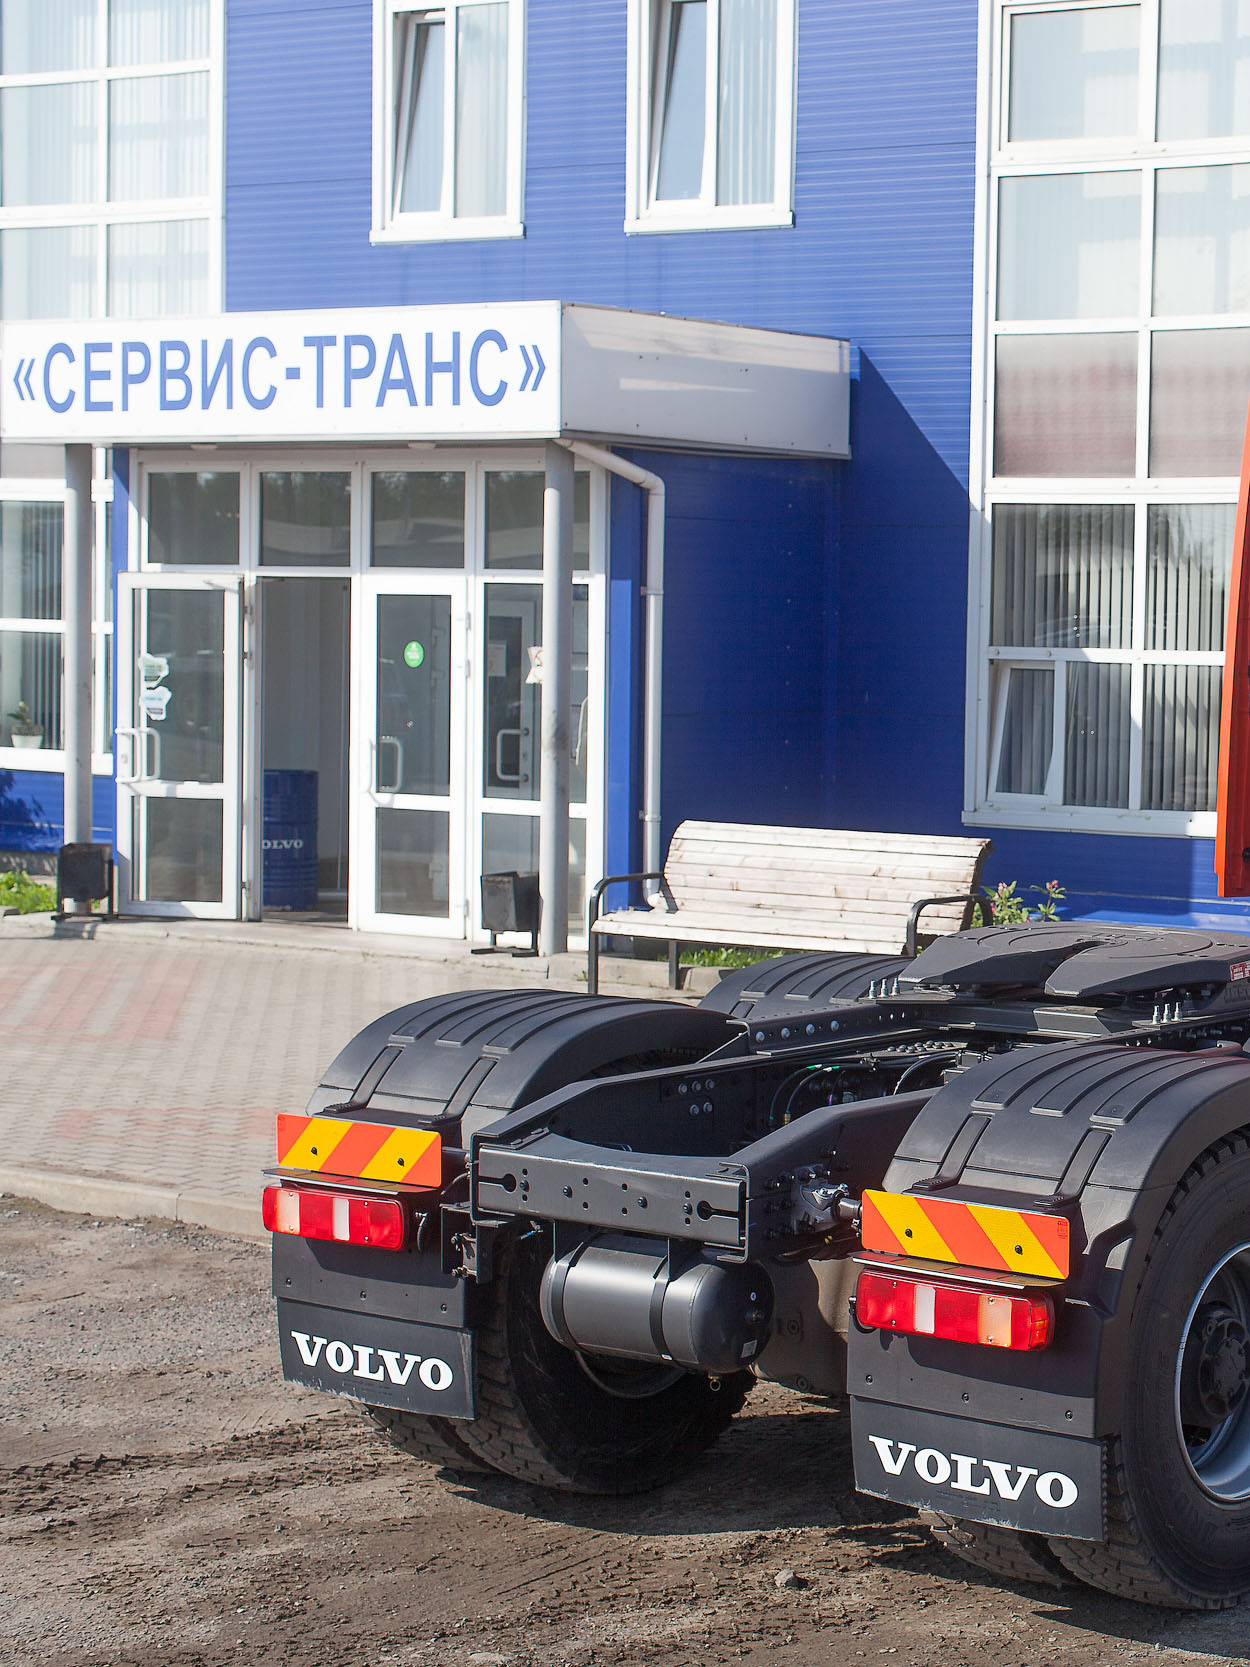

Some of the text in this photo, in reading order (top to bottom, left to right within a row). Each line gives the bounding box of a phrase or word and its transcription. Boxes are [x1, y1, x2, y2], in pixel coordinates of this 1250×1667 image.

[13, 329, 547, 414] «СЕРВИС-ТРАНС»
[262, 839, 304, 850] OLVO
[290, 1330, 454, 1392] VOLVO
[868, 1434, 1079, 1509] VOLVO
